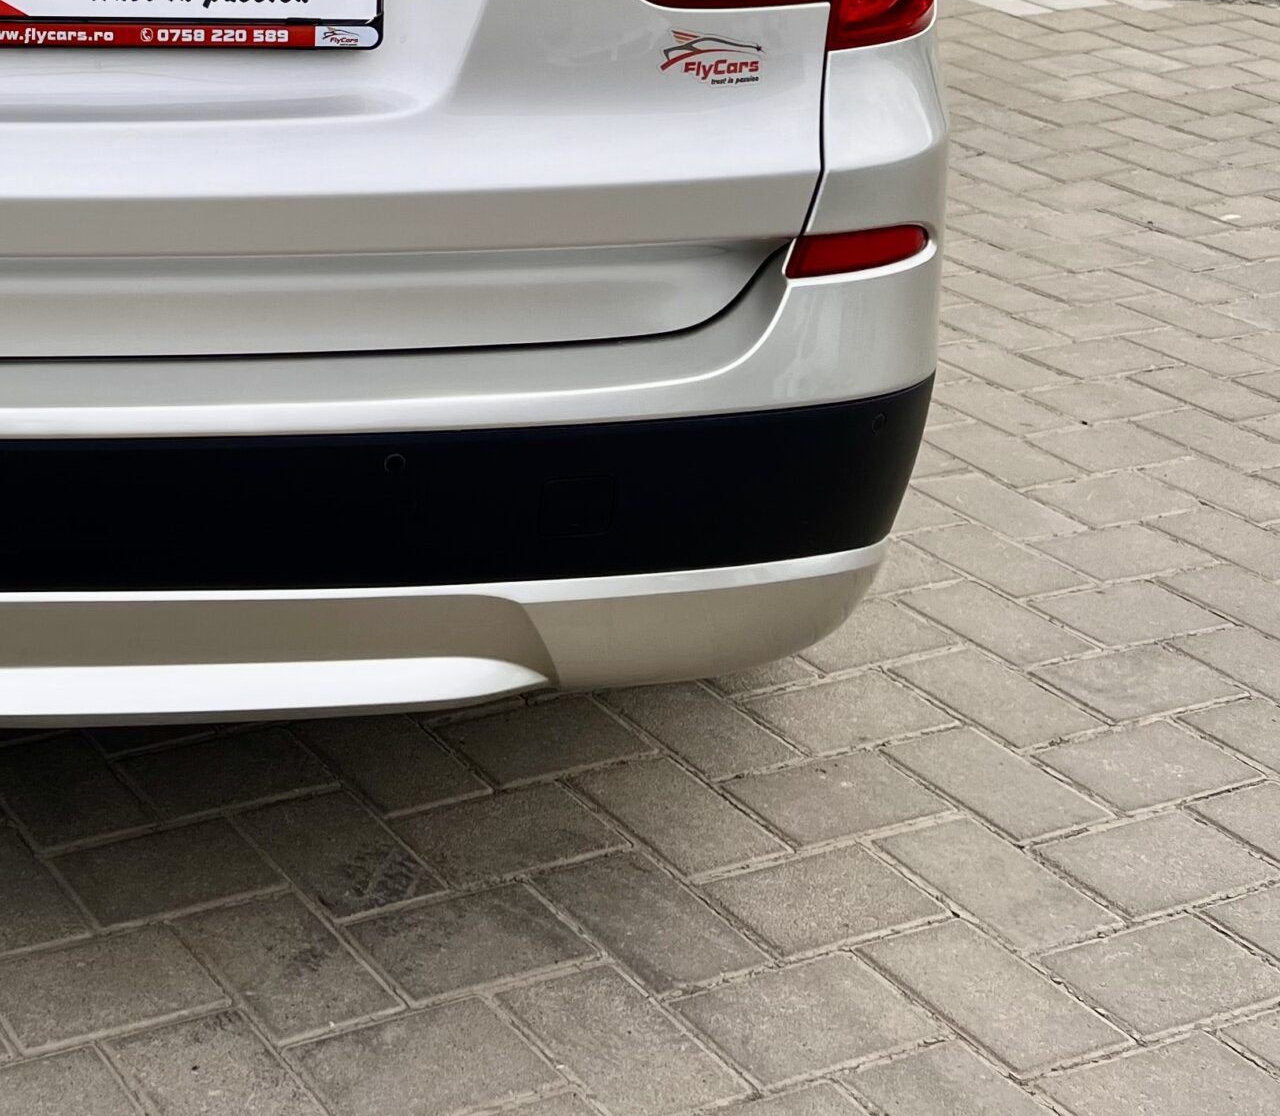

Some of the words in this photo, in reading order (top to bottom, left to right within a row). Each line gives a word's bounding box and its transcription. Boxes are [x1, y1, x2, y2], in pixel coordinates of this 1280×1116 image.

[157, 29, 205, 42] 0758
[211, 29, 247, 42] 220
[253, 30, 289, 43] 589
[683, 59, 759, 80] FlyCars
